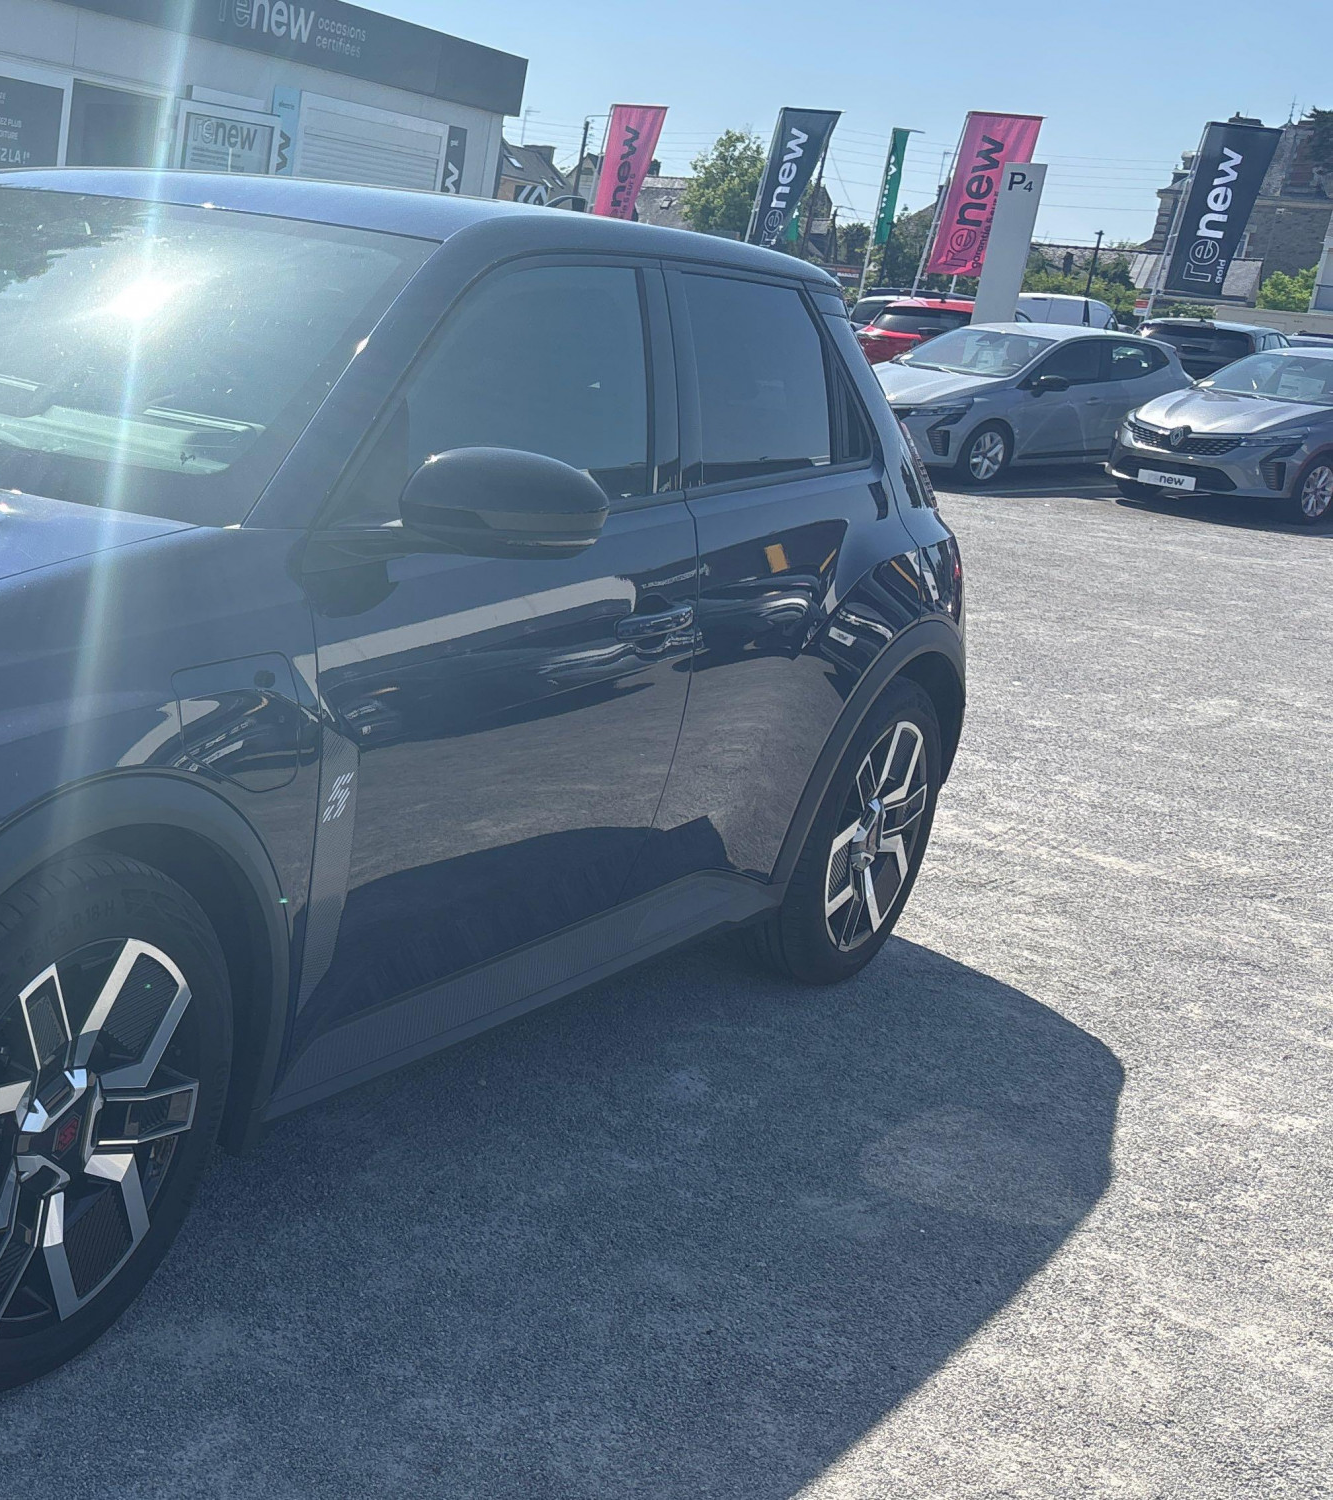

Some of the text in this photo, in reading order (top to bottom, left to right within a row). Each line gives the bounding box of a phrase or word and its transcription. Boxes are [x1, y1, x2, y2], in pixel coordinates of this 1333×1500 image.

[317, 17, 367, 42] occasions
[8, 119, 22, 128] PLUS
[192, 117, 258, 152] renew
[9, 149, 21, 163] LA
[759, 127, 809, 248] renew
[943, 135, 1005, 267] renew
[1182, 147, 1244, 284] renew
[1214, 259, 1227, 284] gold
